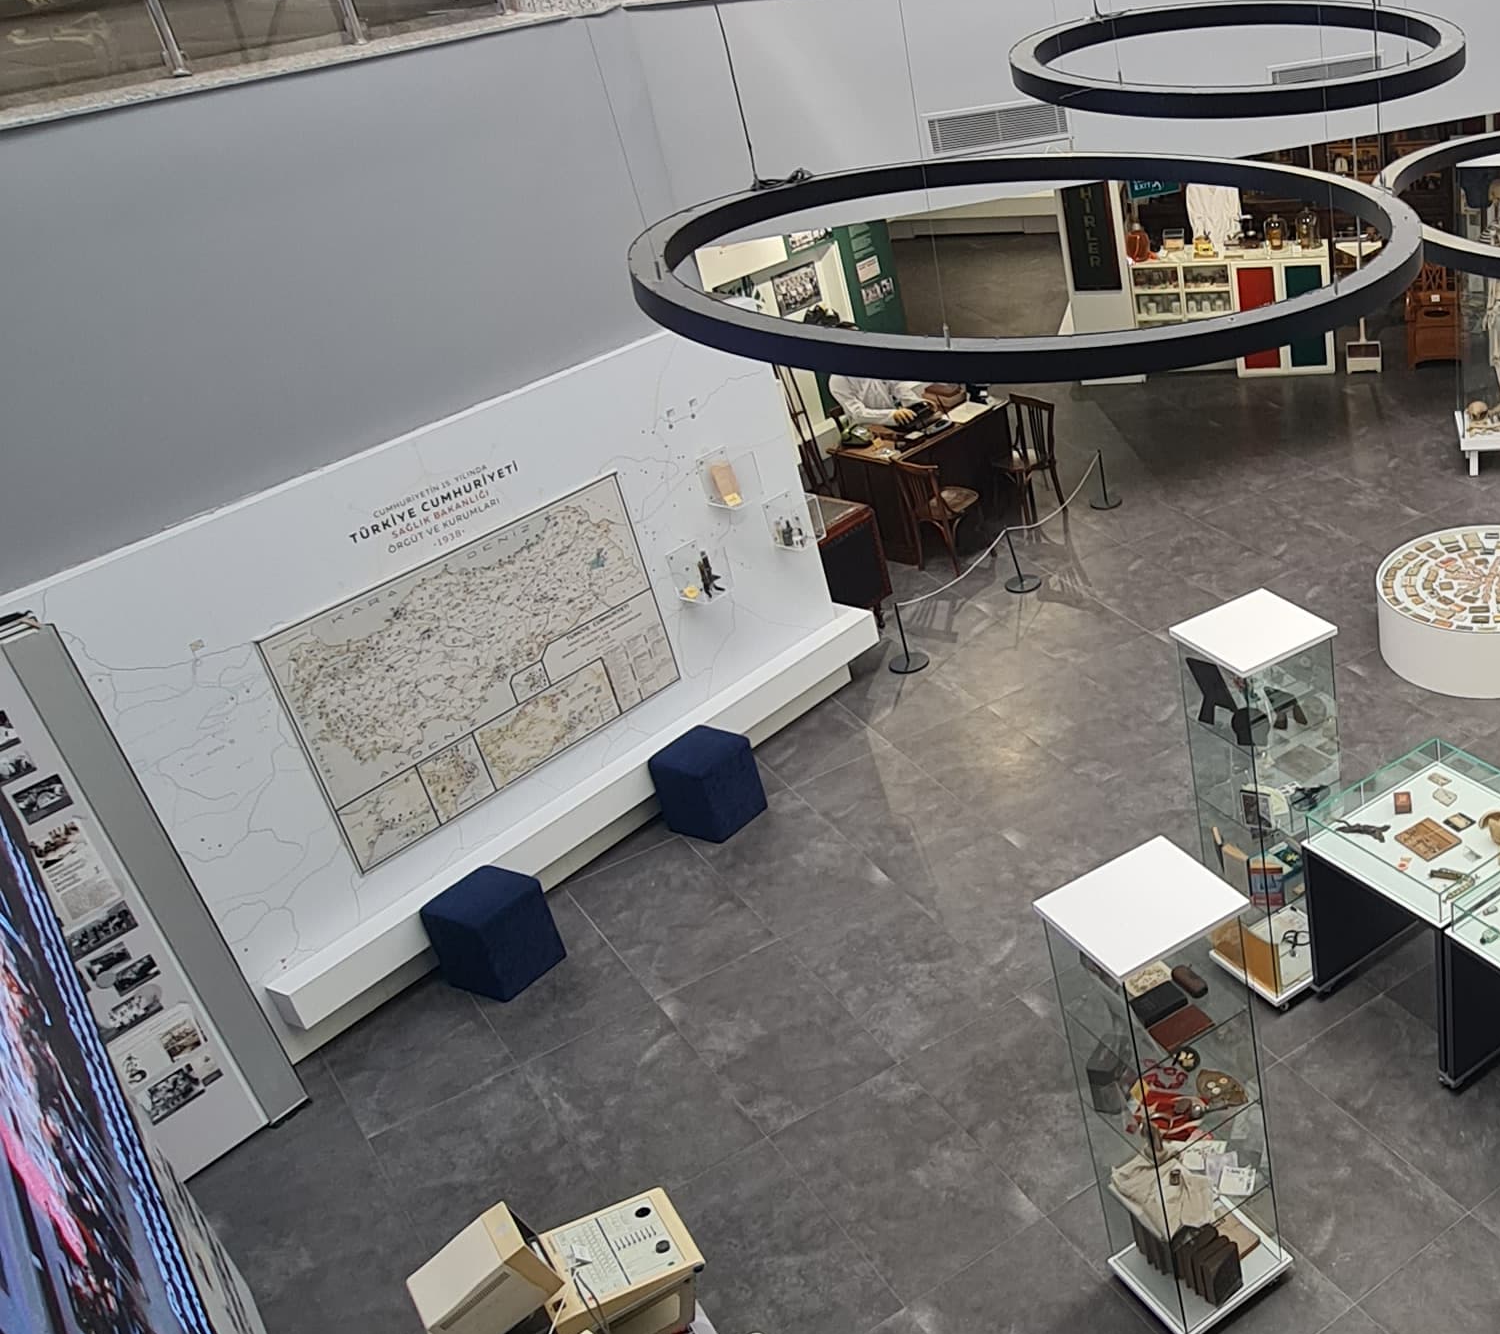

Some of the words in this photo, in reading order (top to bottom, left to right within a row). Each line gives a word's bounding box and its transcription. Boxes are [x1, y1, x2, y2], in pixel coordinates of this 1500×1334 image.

[454, 464, 488, 483] YILINDA
[349, 507, 417, 544] TÜRKİYE
[421, 460, 519, 512] CUMHURİYETİ
[388, 531, 425, 554] ÖRGÜT
[426, 525, 441, 536] VE
[442, 498, 500, 529] KURUMLARI
[391, 516, 431, 539] SAĞLIK
[433, 490, 490, 520] BAKANLIĞI
